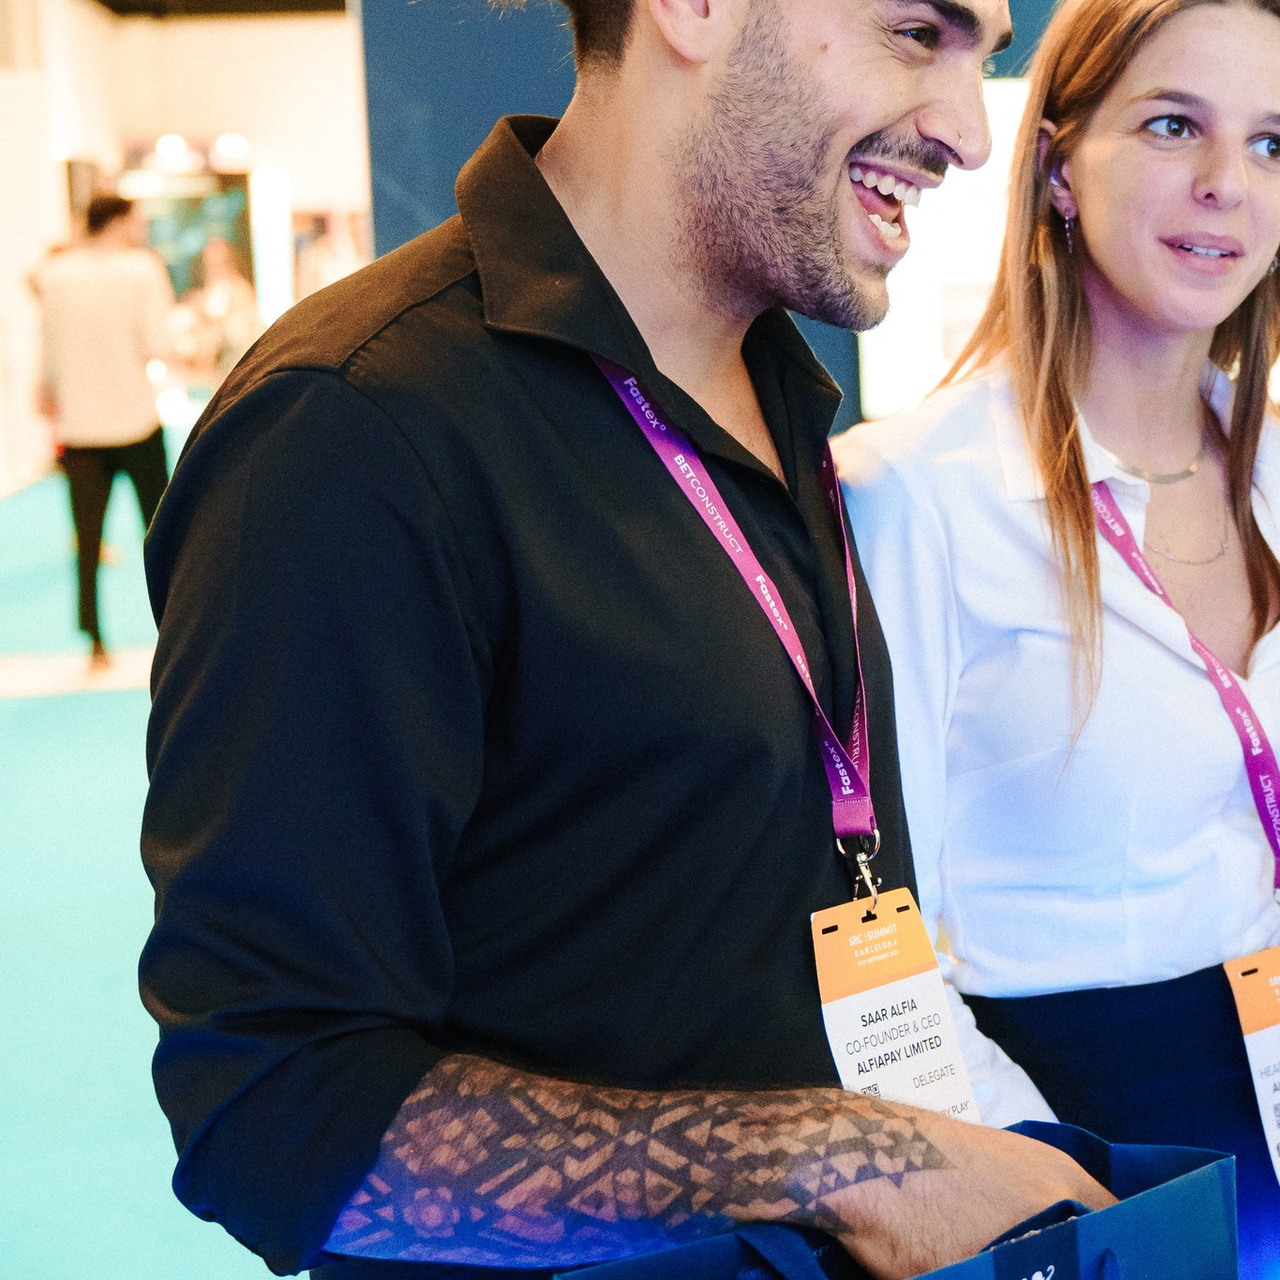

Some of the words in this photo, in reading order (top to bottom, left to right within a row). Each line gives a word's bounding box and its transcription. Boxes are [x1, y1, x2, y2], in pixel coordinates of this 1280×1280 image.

[674, 454, 743, 553] BETCONSTRUCT
[845, 1022, 910, 1055] CO-FOUNDER
[920, 1012, 942, 1031] CEO
[860, 1008, 889, 1027] SAAR
[890, 998, 918, 1017] ALFIA
[857, 1049, 902, 1076] ALFIAPAY
[903, 1034, 942, 1060] LIMITED
[912, 1064, 956, 1089] DELEGATE
